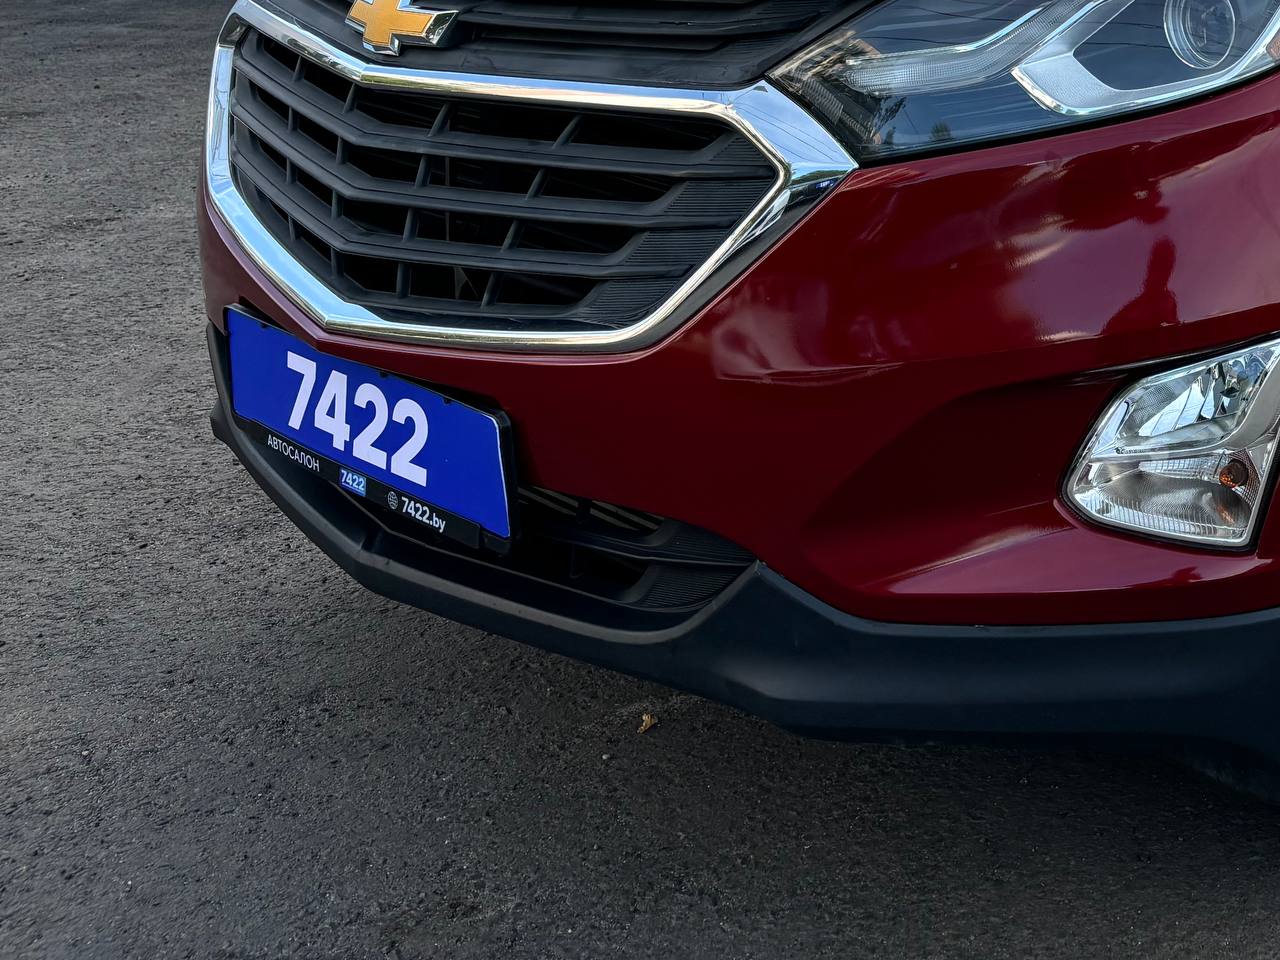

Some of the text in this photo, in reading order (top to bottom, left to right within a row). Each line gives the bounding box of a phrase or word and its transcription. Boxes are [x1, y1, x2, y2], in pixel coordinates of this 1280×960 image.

[287, 351, 429, 487] 7422
[267, 433, 320, 473] АВТОСАЛОН
[340, 468, 366, 491] 7422
[401, 496, 447, 533] 7422.by
